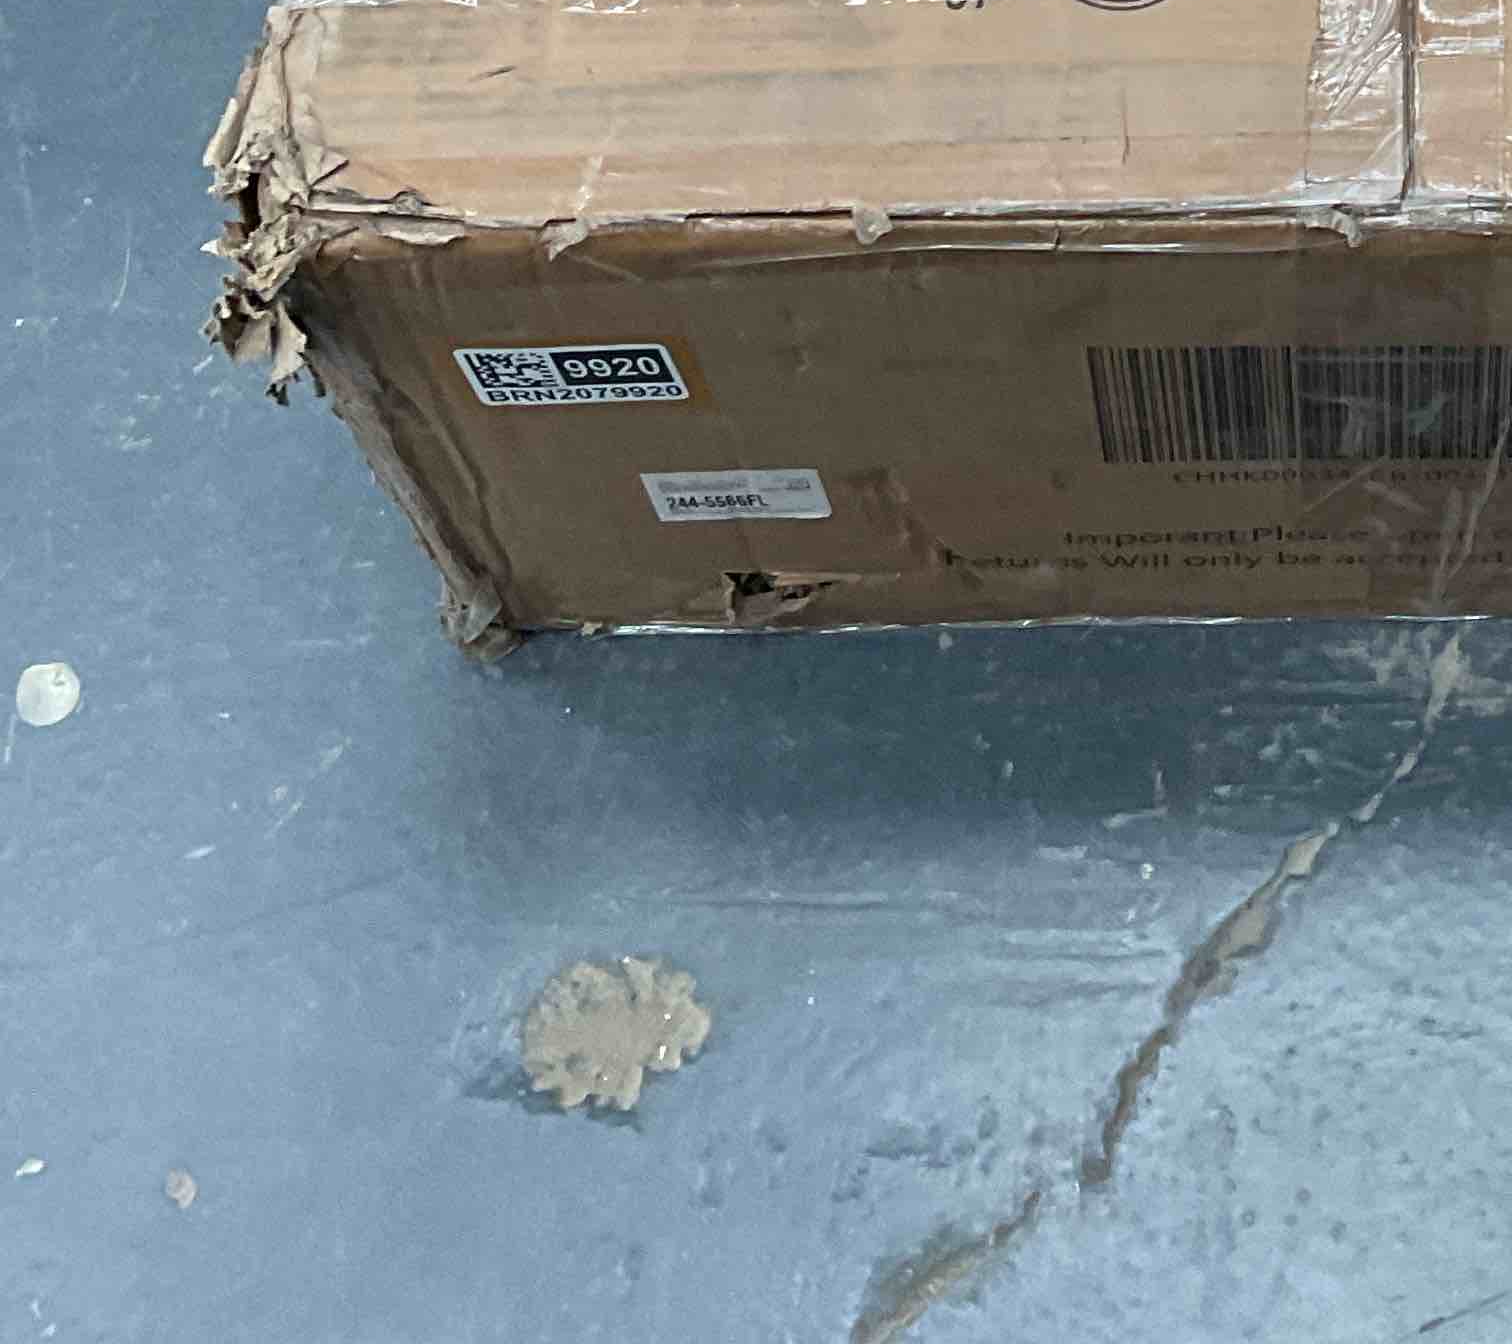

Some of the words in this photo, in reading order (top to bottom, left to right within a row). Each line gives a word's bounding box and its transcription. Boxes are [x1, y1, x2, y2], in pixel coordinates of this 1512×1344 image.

[562, 355, 662, 379] 9920
[485, 382, 684, 403] BRN2079920
[1102, 551, 1170, 569] Will
[1183, 550, 1263, 571] only
[1277, 550, 1321, 567] be
